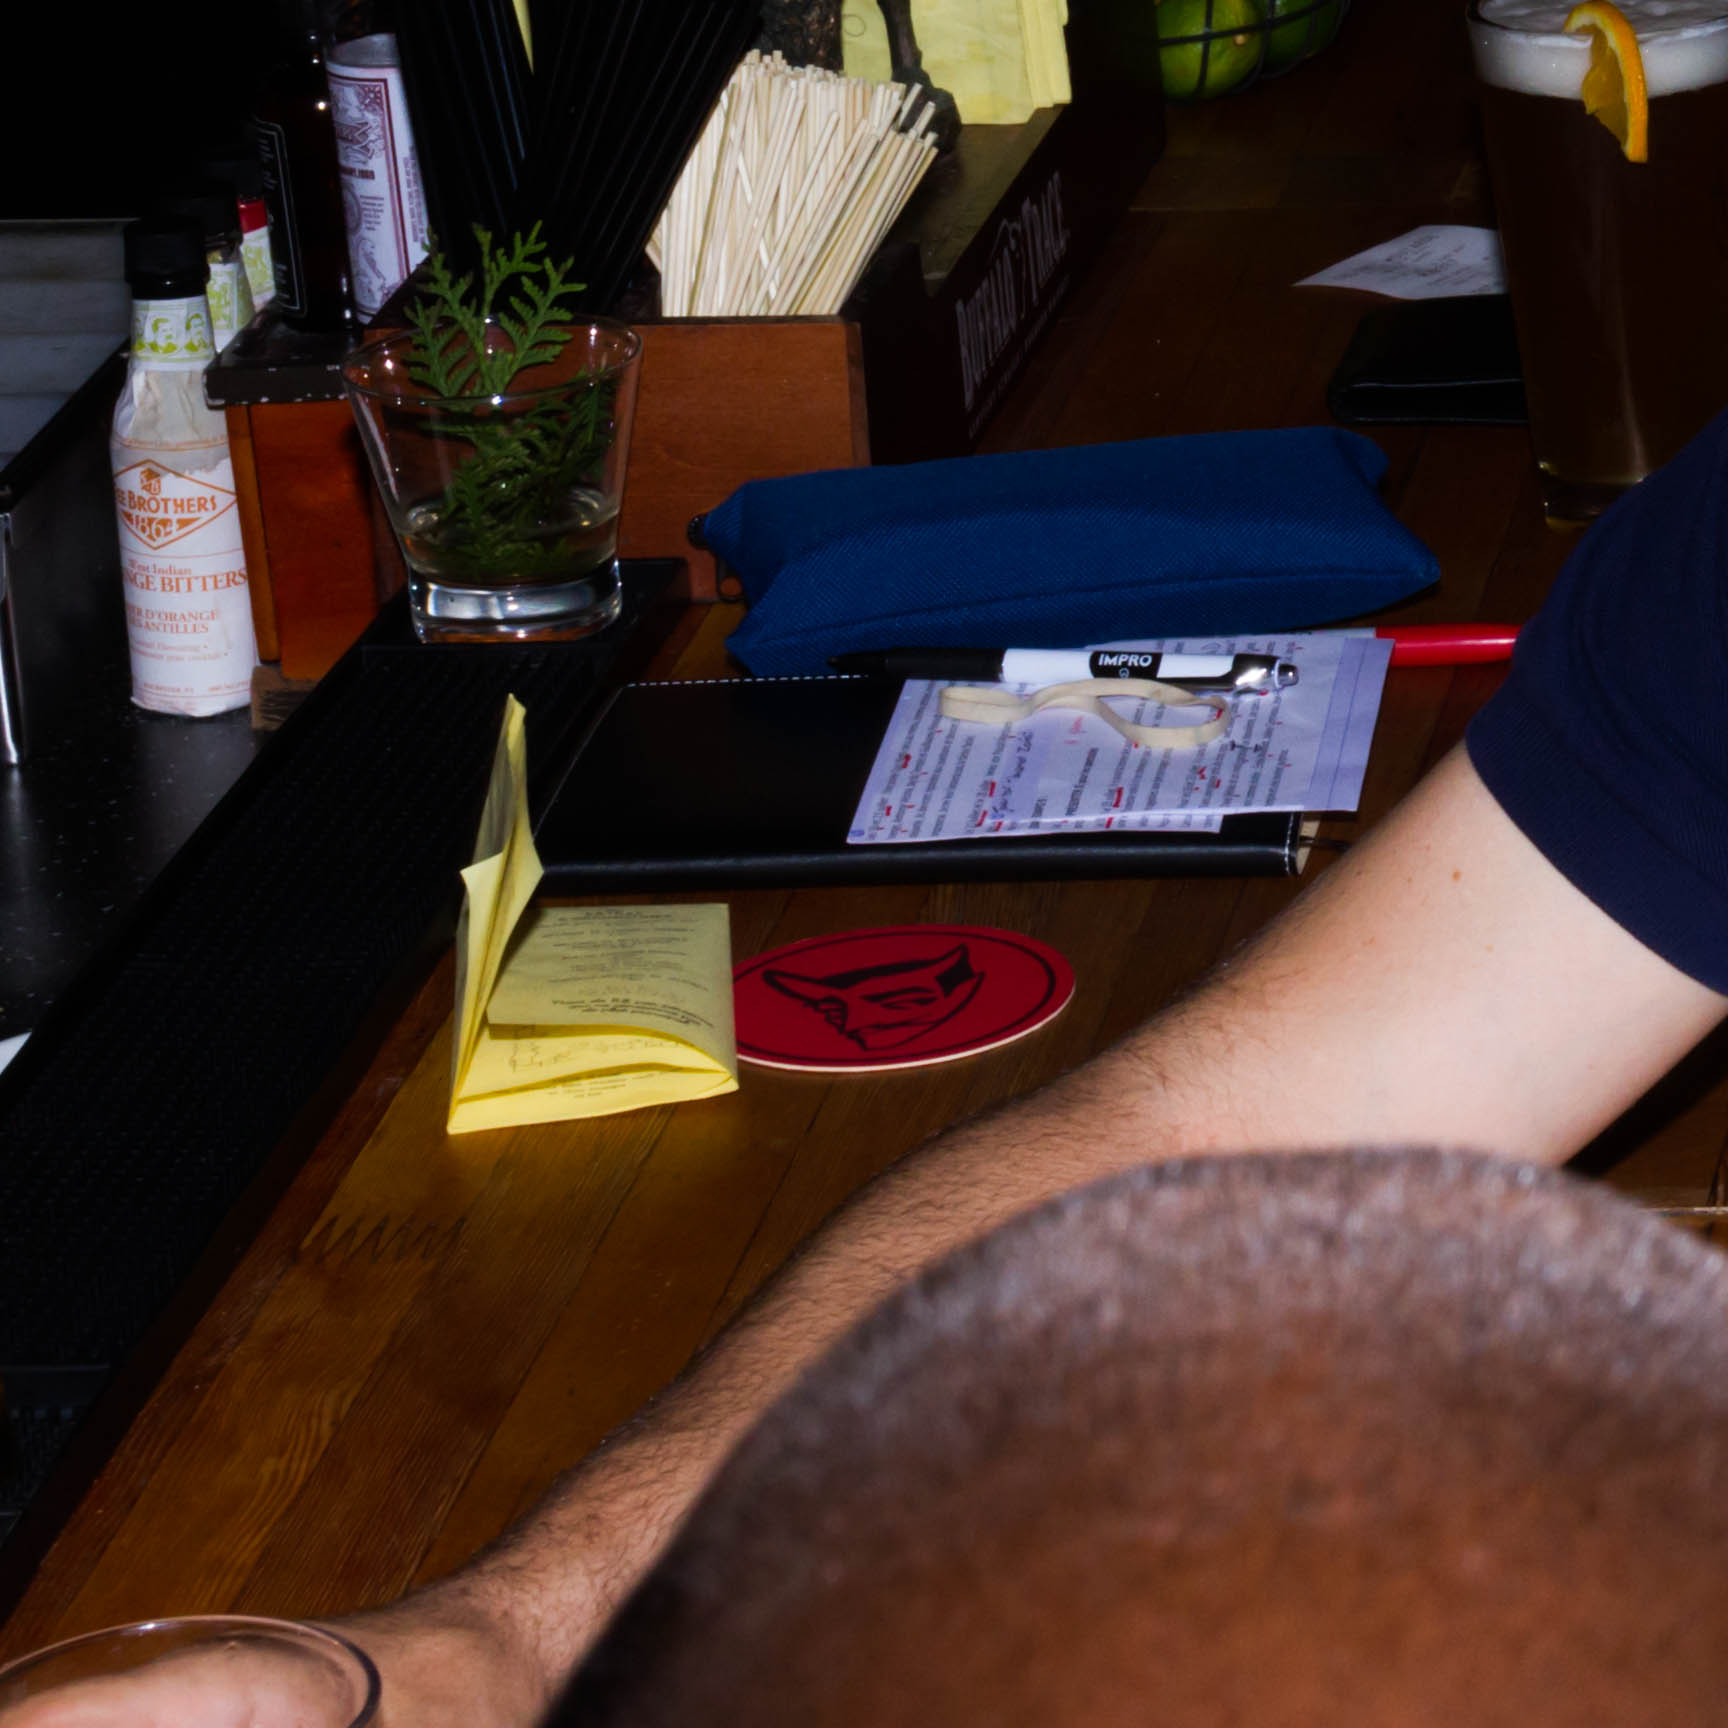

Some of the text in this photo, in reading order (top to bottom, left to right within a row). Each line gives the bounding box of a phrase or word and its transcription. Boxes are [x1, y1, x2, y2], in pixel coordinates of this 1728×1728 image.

[127, 489, 217, 514] BROTHERS
[124, 569, 248, 592] NGE BITTERS
[1098, 653, 1152, 667] IMPRO
